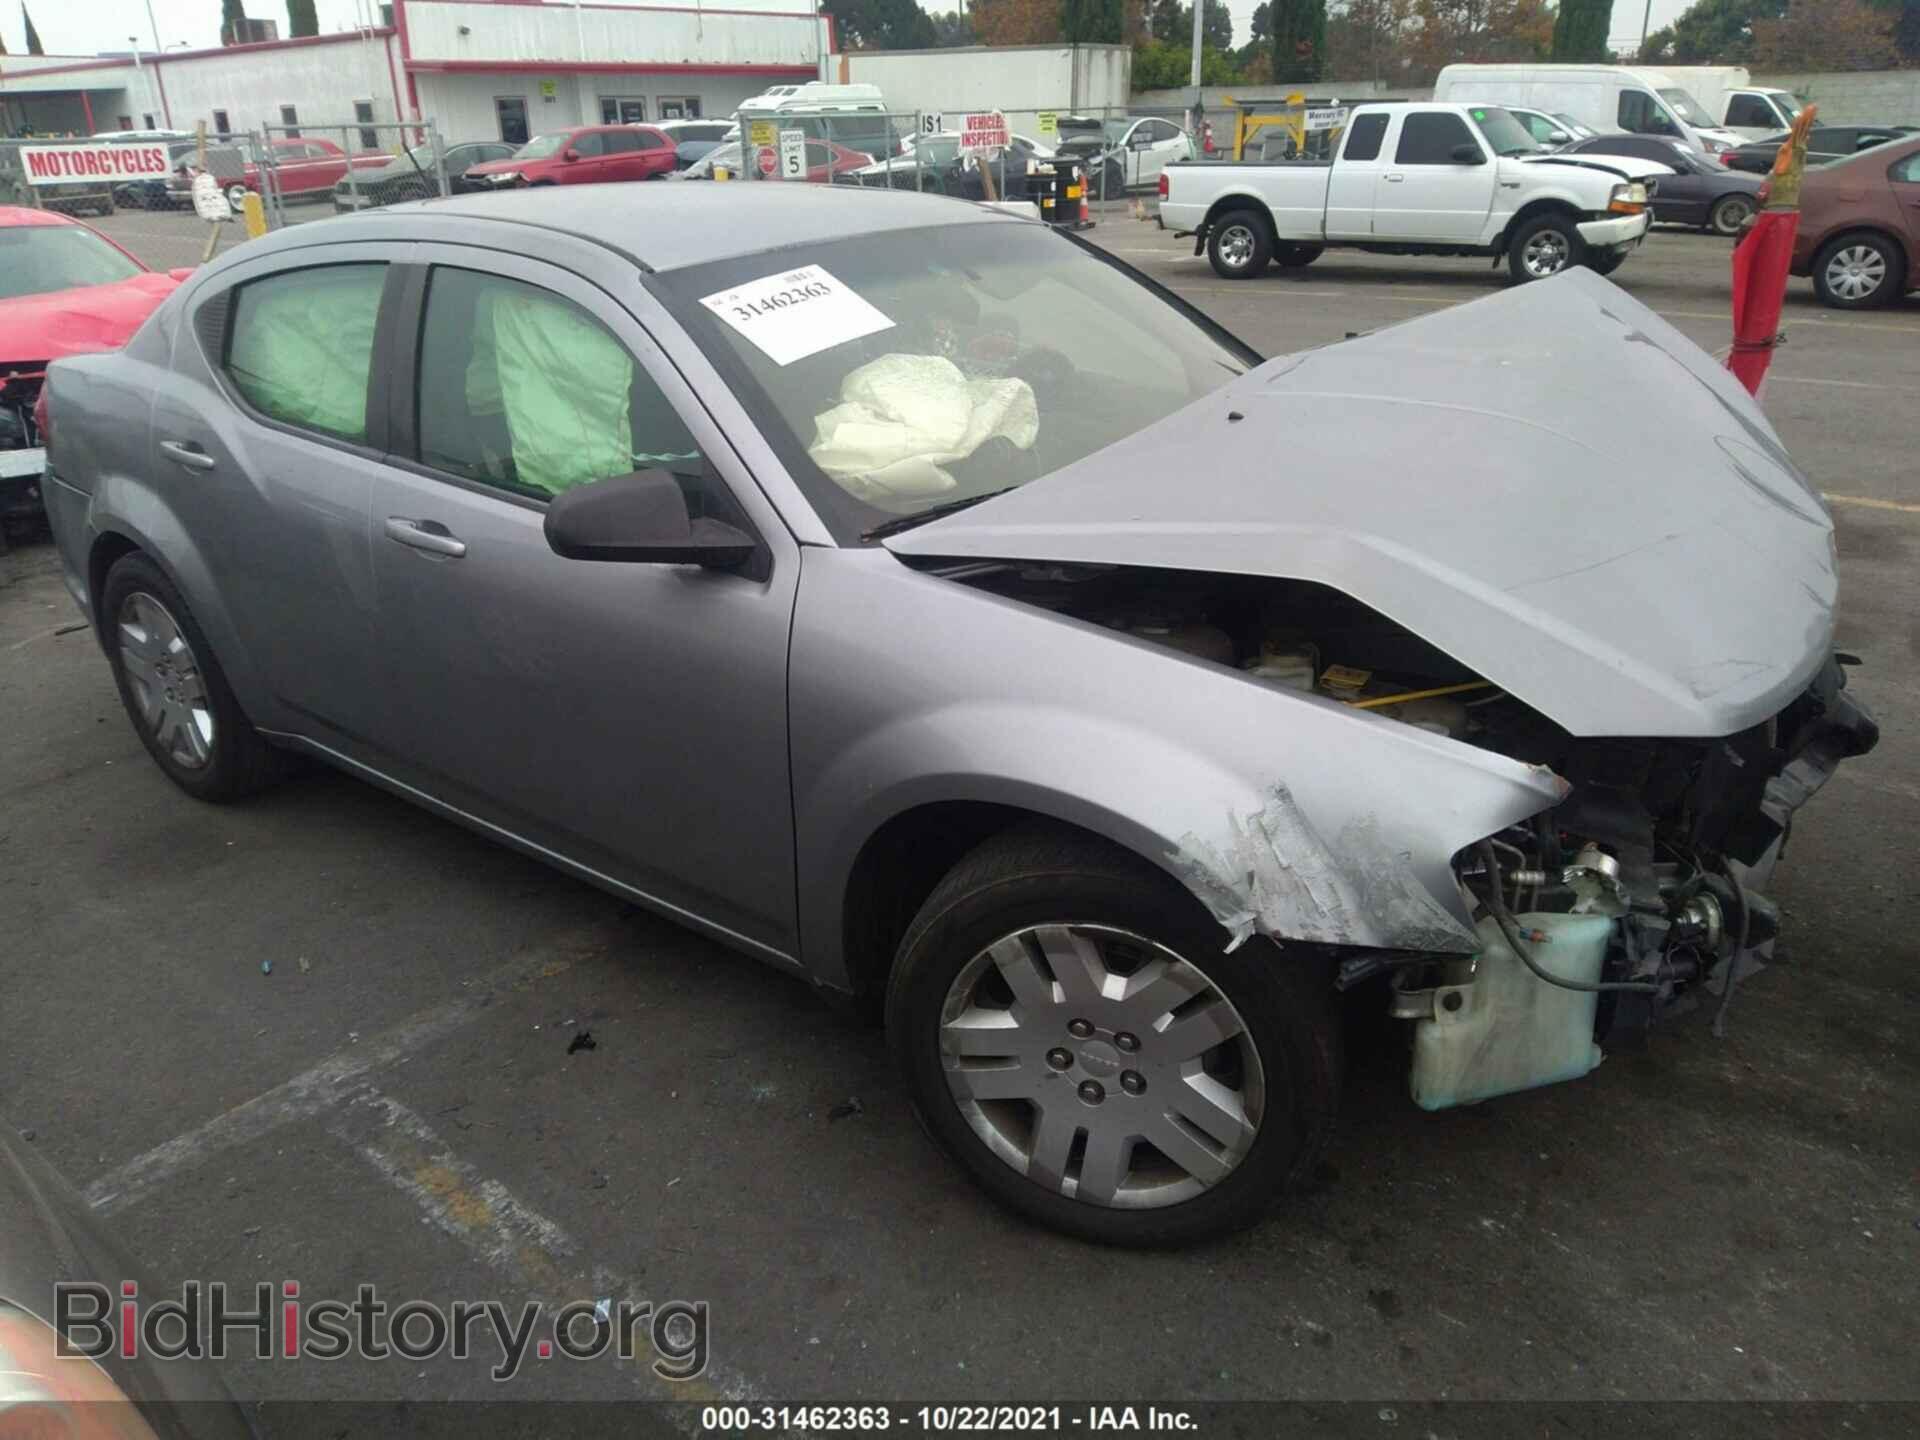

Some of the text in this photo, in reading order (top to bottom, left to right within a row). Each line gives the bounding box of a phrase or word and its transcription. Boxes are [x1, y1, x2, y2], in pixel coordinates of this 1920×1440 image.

[922, 115, 942, 133] IS 1
[26, 148, 167, 177] MOTORCYCLES
[789, 155, 800, 174] 5
[732, 281, 832, 321] 31462363
